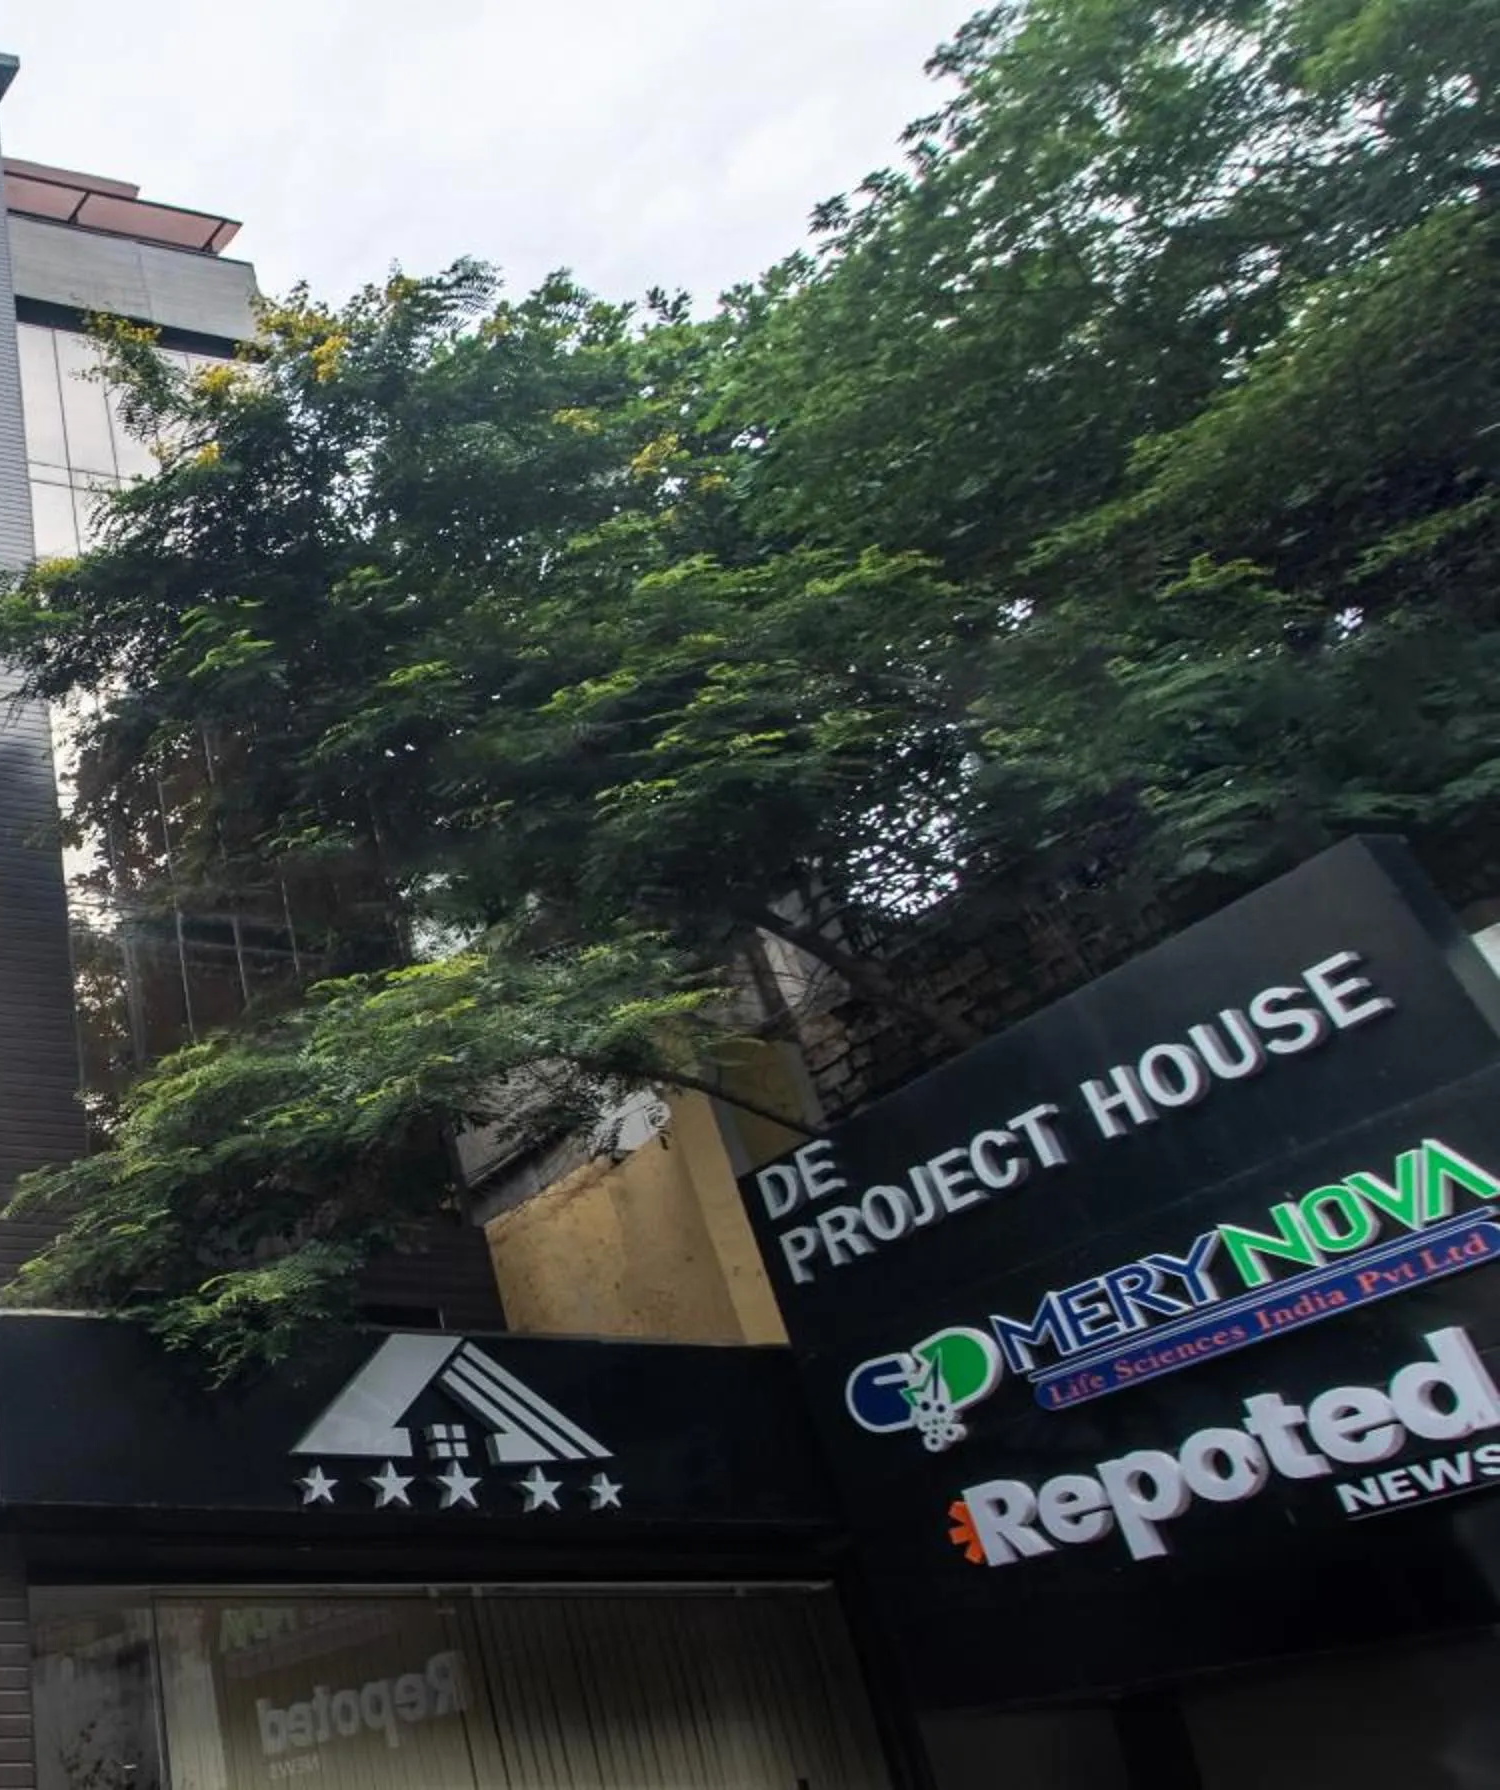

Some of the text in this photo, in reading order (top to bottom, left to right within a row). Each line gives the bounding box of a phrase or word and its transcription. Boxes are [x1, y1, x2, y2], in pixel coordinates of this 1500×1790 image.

[756, 1139, 848, 1220] DE
[778, 951, 1395, 1284] PROJECT HOUSE
[1049, 1232, 1489, 1405] Life Sciences India Pvt Ltd
[962, 1326, 1500, 1567] Repoted
[1335, 1443, 1500, 1513] NEWS
